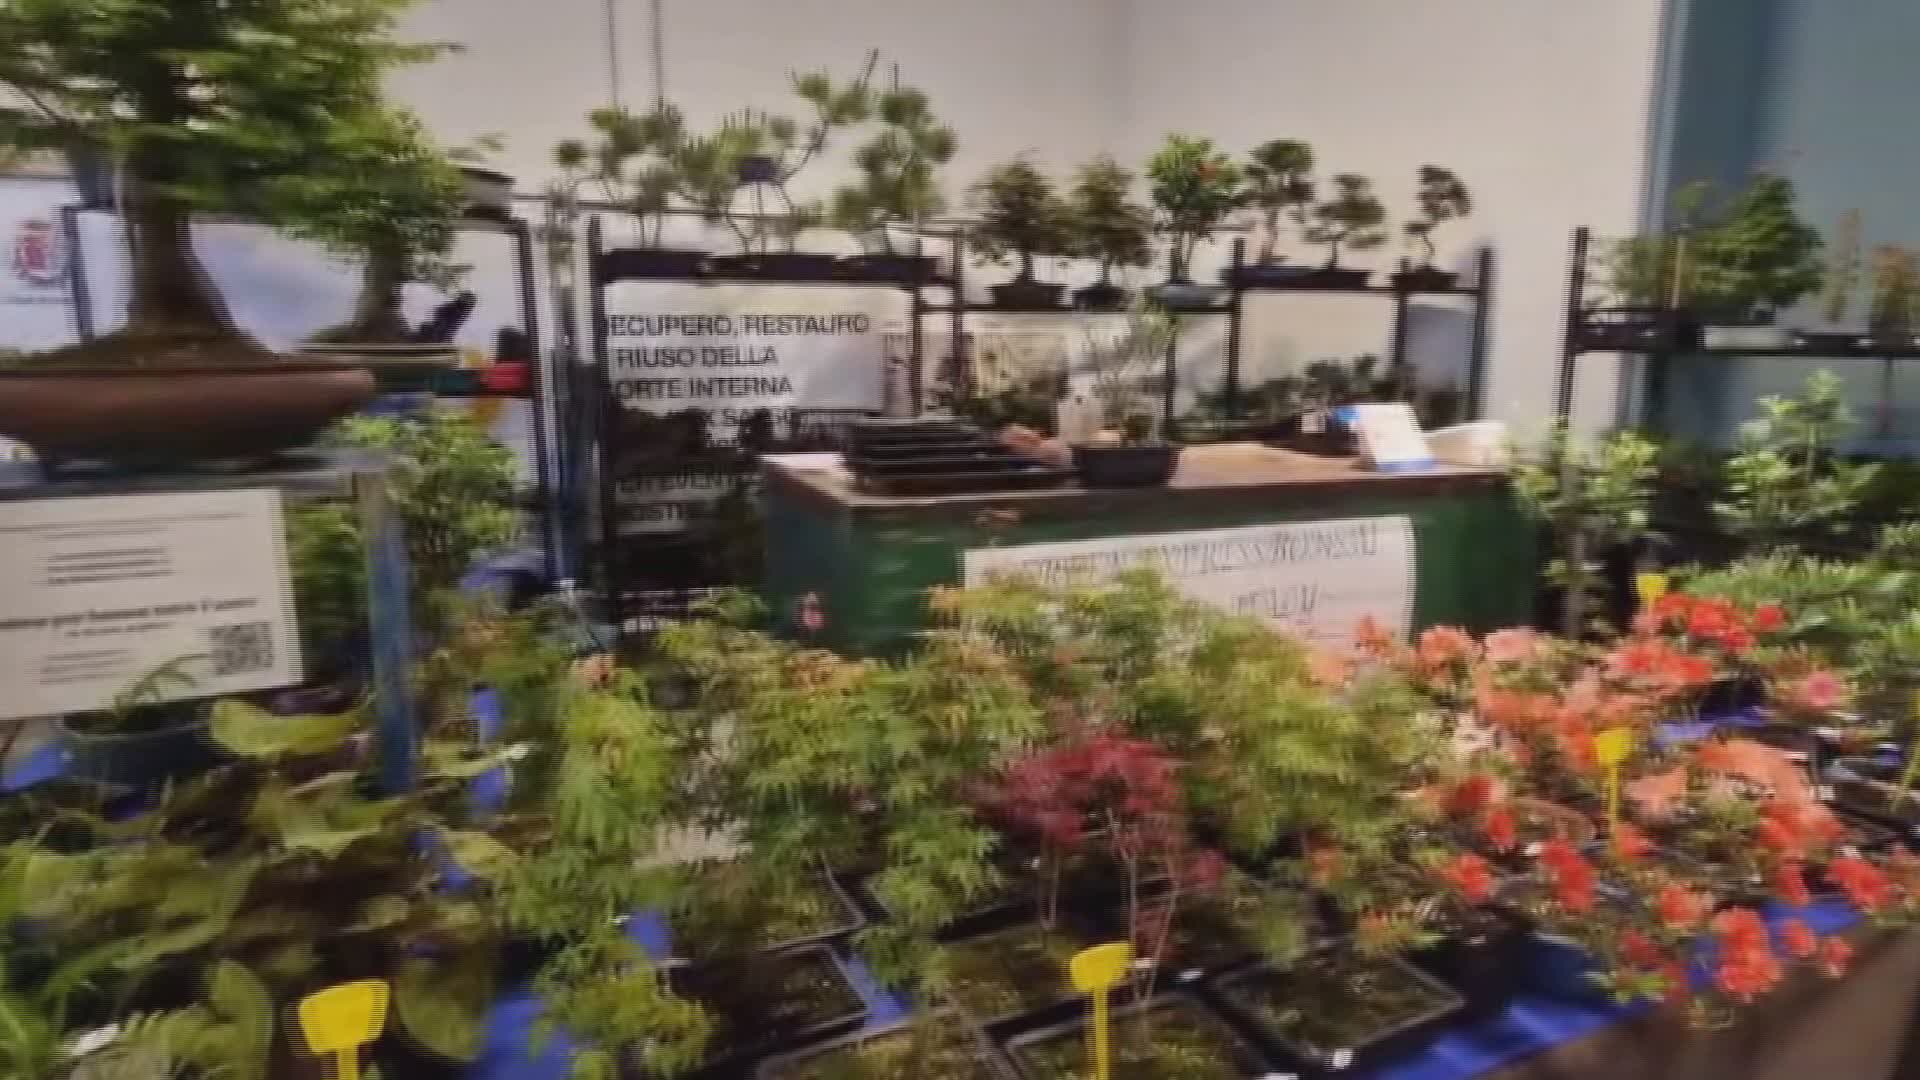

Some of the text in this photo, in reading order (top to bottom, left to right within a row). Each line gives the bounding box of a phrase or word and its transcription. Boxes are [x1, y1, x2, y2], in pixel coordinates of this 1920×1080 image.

[606, 313, 871, 337] ECUPERO, RESTAURO
[617, 345, 780, 368] RIUSO DELLA
[615, 376, 794, 400] ORTE INTERNA
